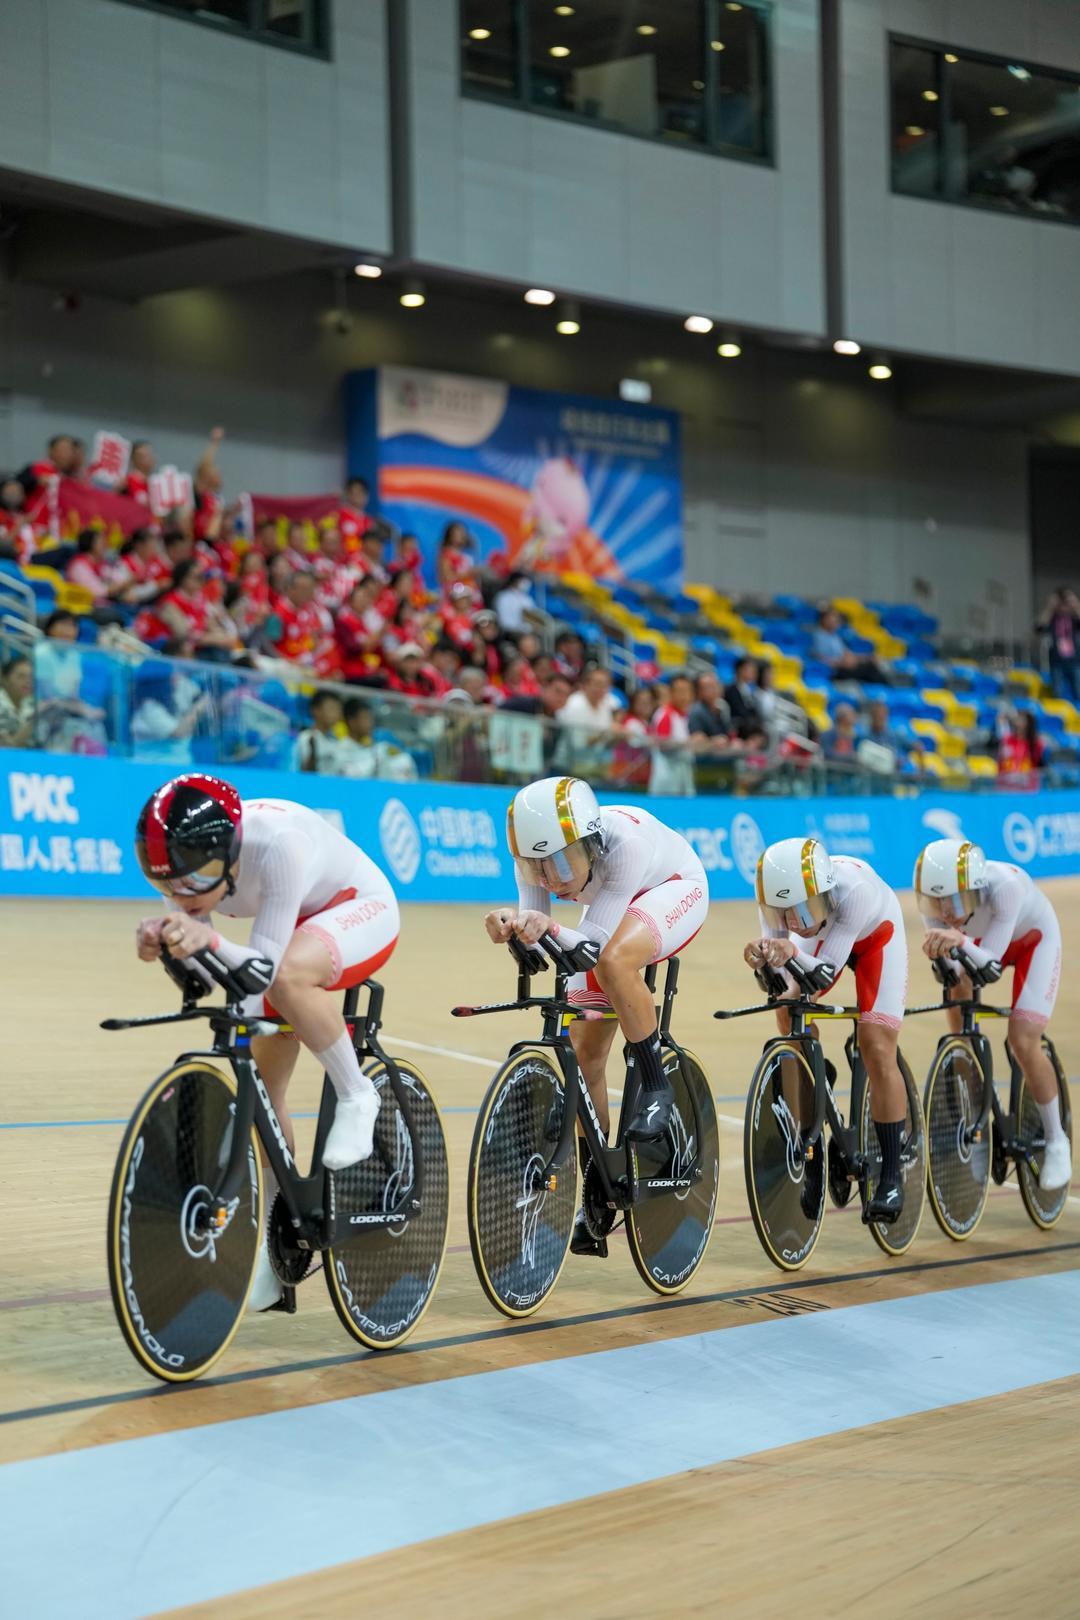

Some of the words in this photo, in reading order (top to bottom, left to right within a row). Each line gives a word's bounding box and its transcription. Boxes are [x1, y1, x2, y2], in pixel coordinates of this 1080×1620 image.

[9, 771, 79, 824] PICC
[248, 1058, 294, 1169] LOOK
[486, 1064, 565, 1145] AMPAGNOLO
[577, 1065, 606, 1148] OOK
[121, 1136, 185, 1367] CAMPAGNOLO
[349, 1215, 385, 1224] LOOK
[386, 1213, 405, 1222] P24
[336, 1260, 437, 1336] CAMPAGNOLO
